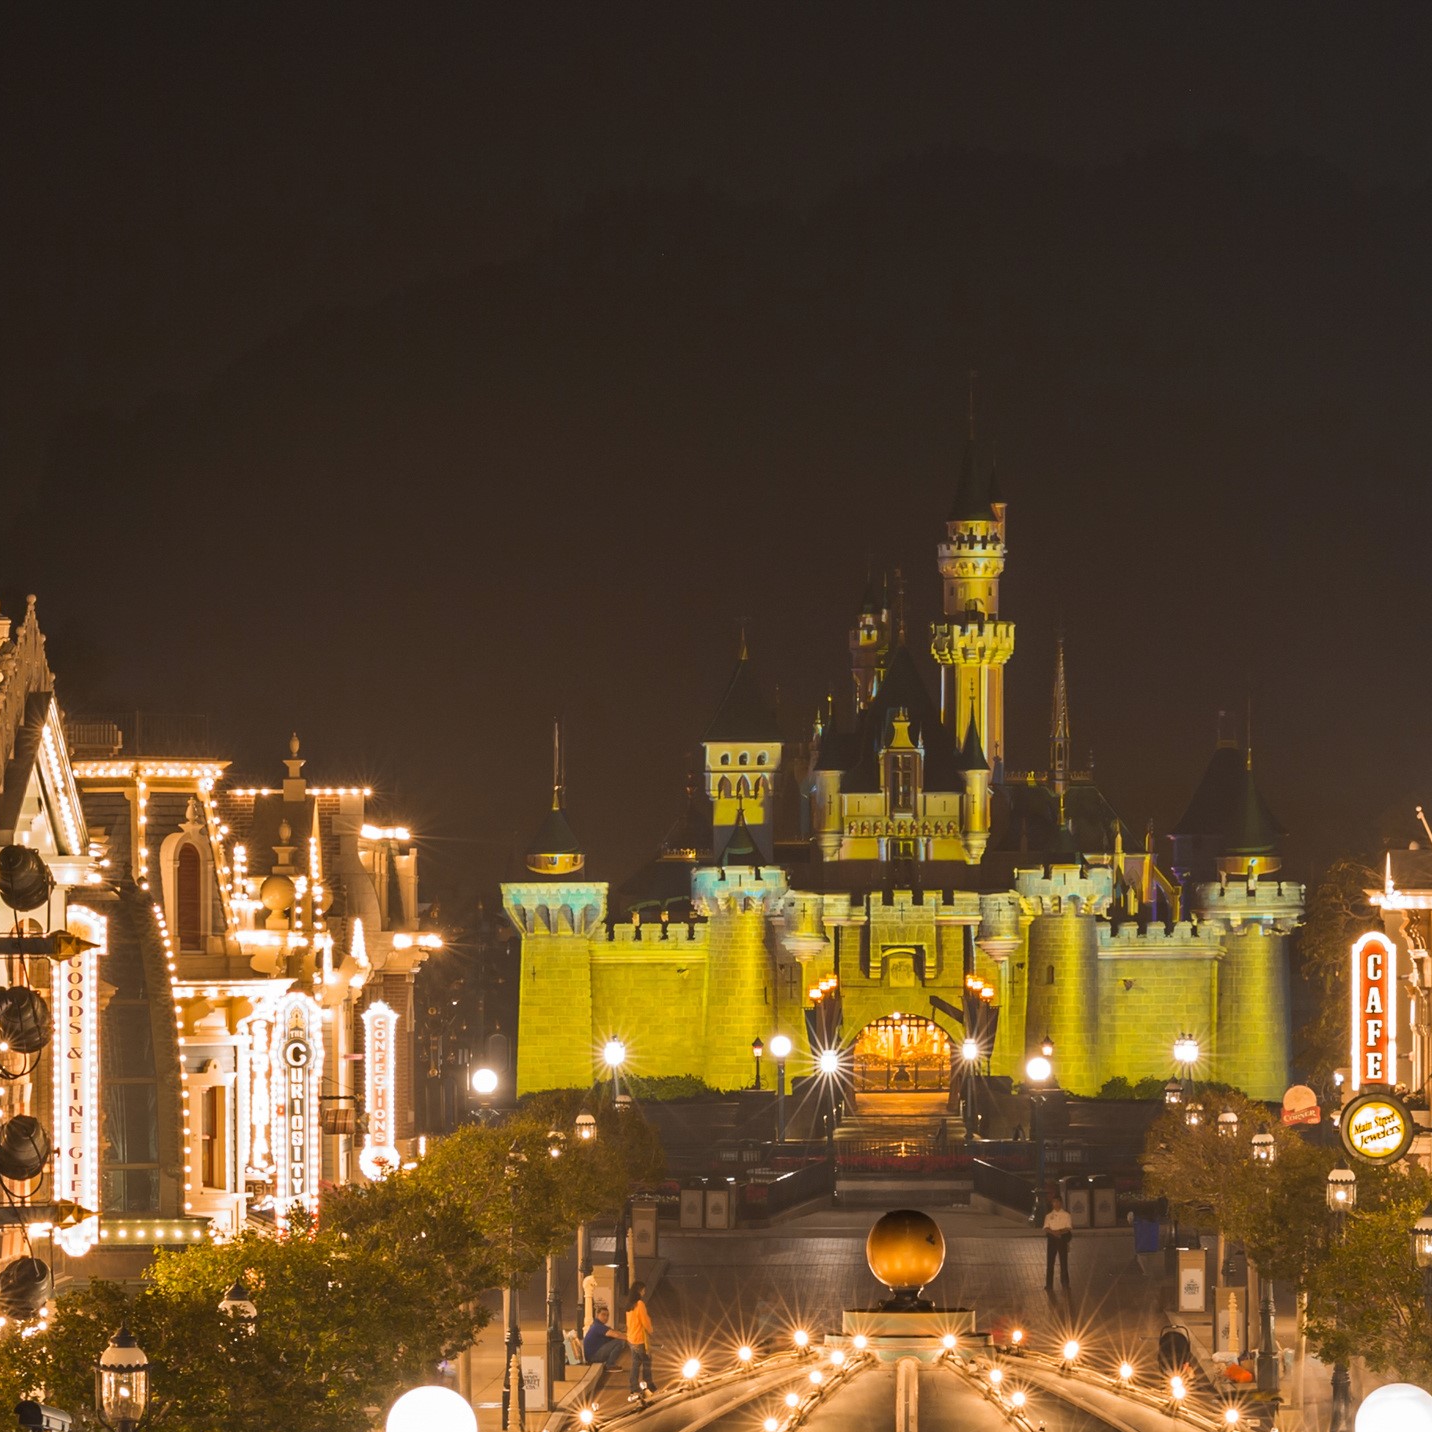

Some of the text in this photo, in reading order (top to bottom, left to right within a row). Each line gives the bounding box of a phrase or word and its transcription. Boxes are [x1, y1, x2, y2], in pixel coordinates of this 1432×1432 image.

[67, 955, 84, 1035] GOODS
[1365, 954, 1383, 1079] CAFE
[67, 1047, 83, 1059] &
[69, 1072, 83, 1134] FINE
[374, 1017, 386, 1143] CONFECTIONS
[286, 1042, 307, 1194] CURIOSITY
